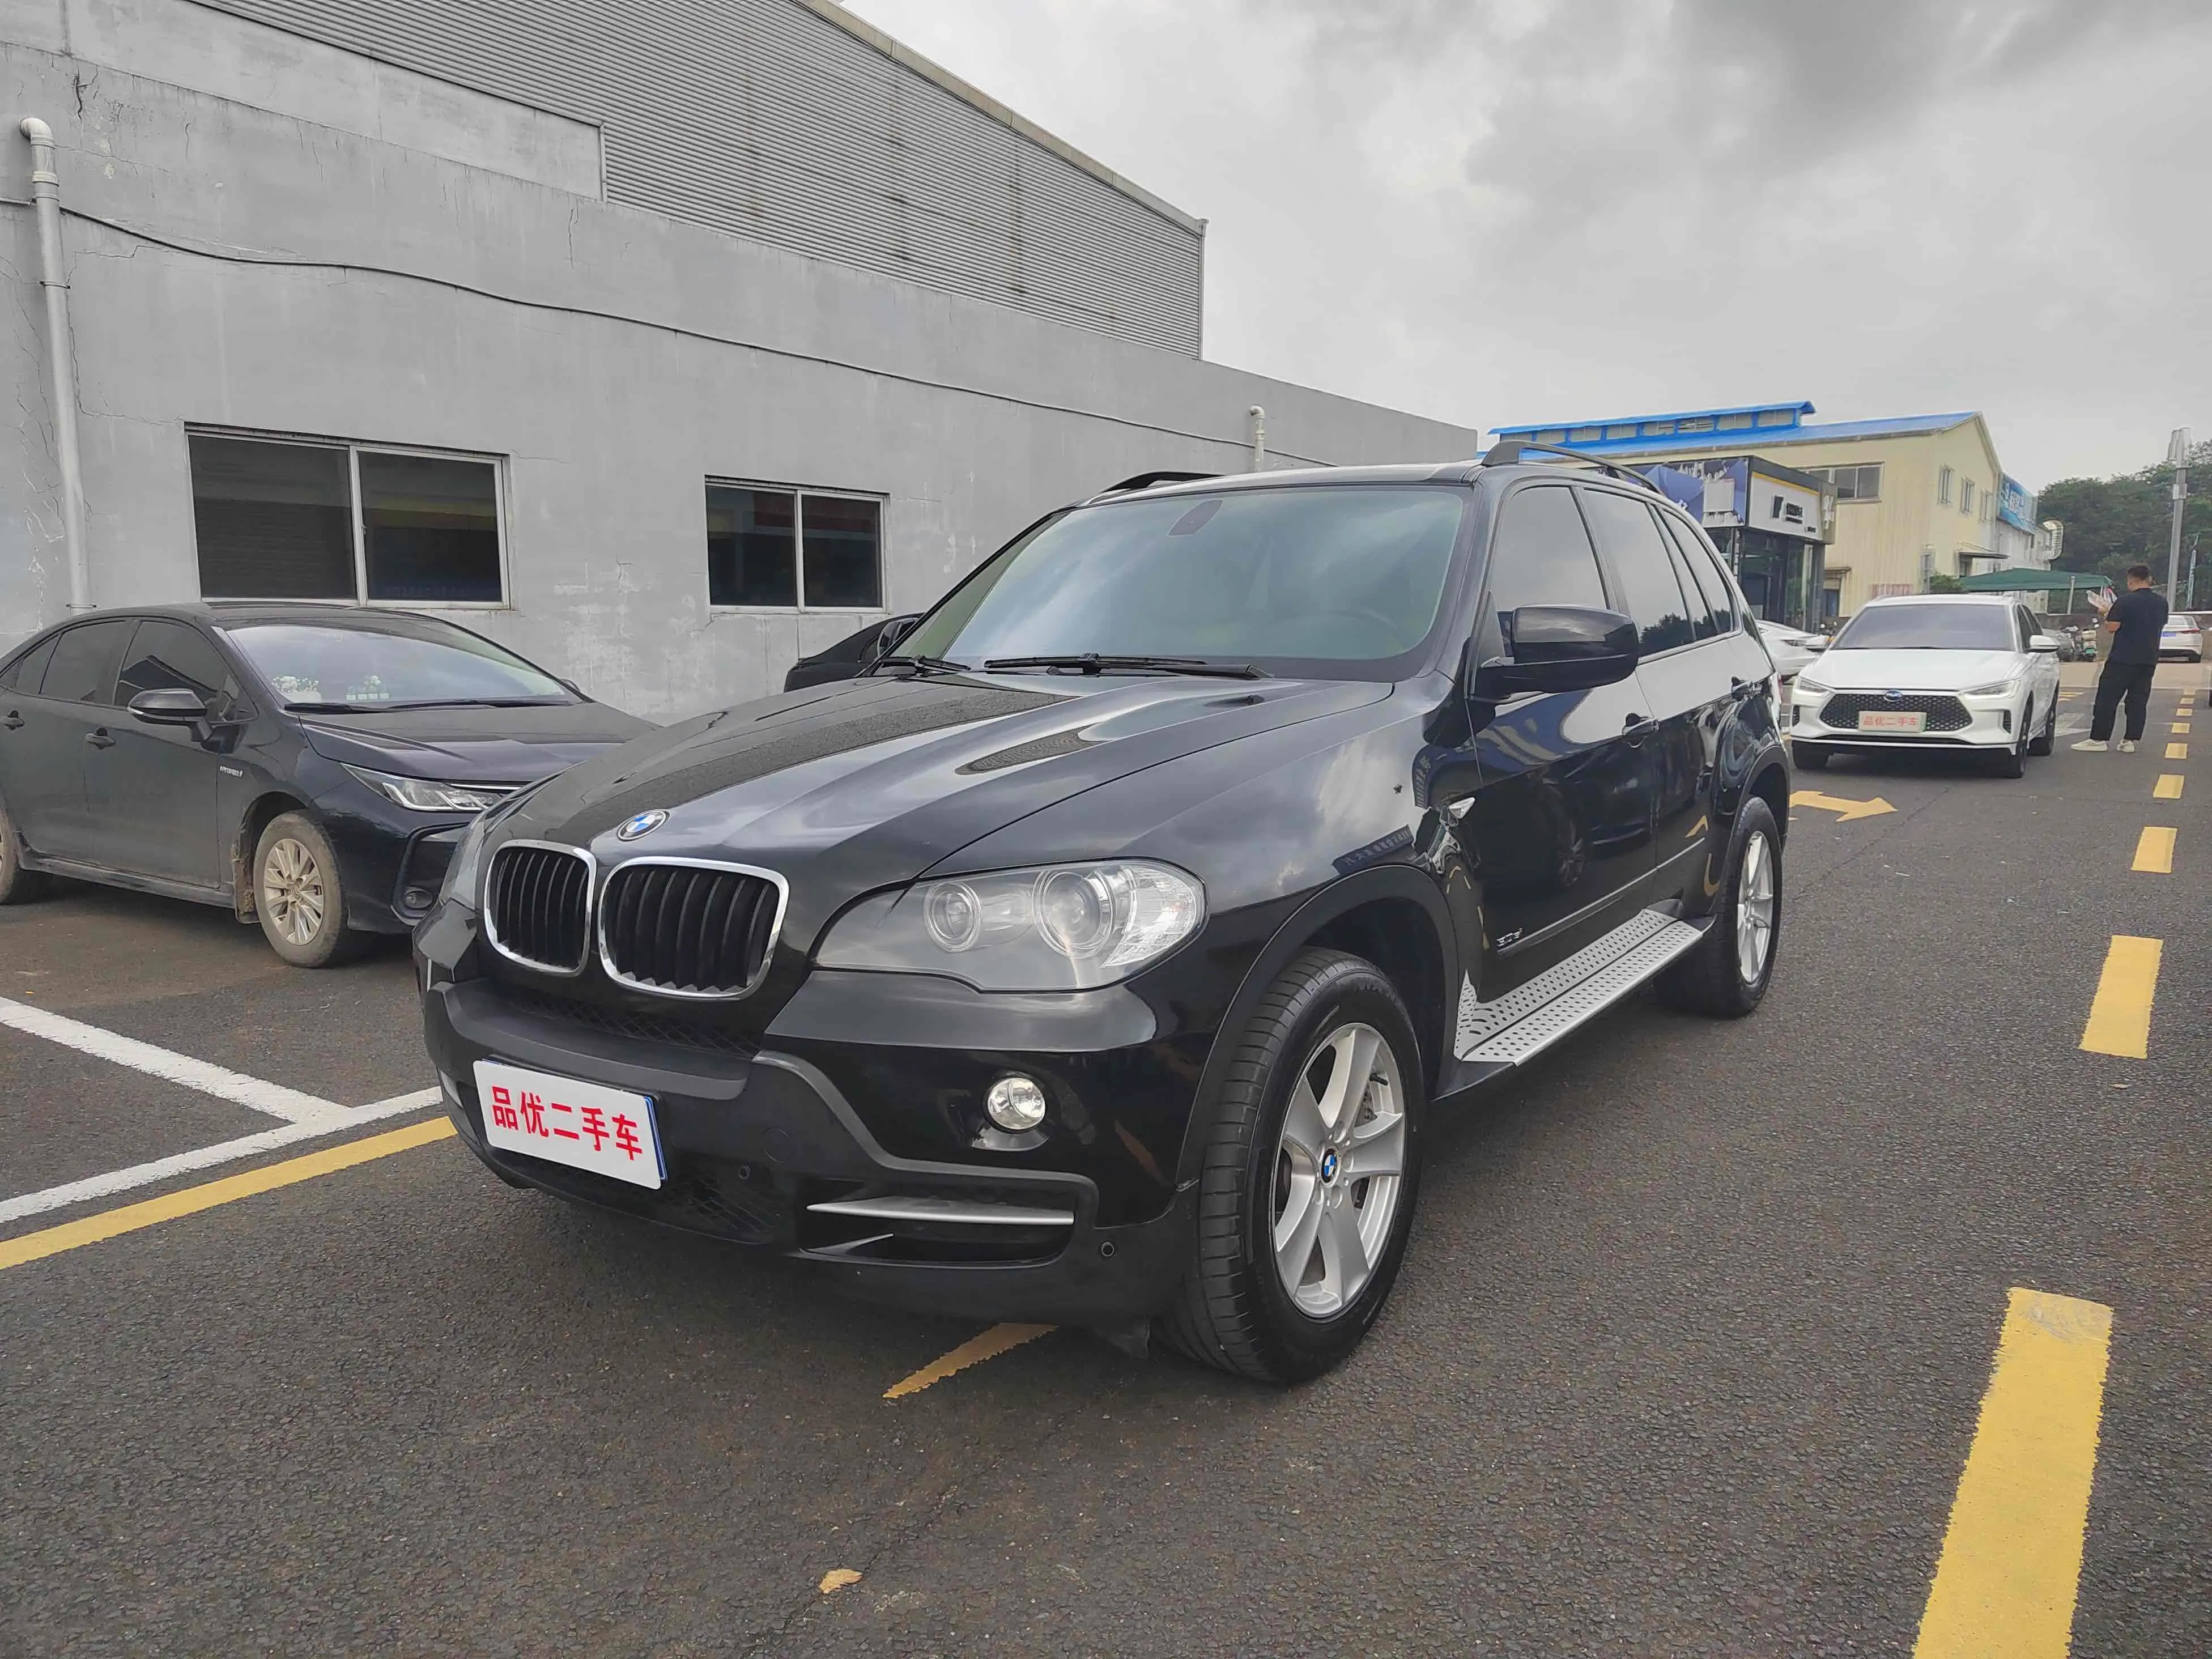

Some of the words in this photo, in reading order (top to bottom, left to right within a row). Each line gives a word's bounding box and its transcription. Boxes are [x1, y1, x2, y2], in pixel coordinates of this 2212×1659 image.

[1863, 715, 1918, 726] 品优二手车
[491, 1084, 643, 1160] 品优二手车
